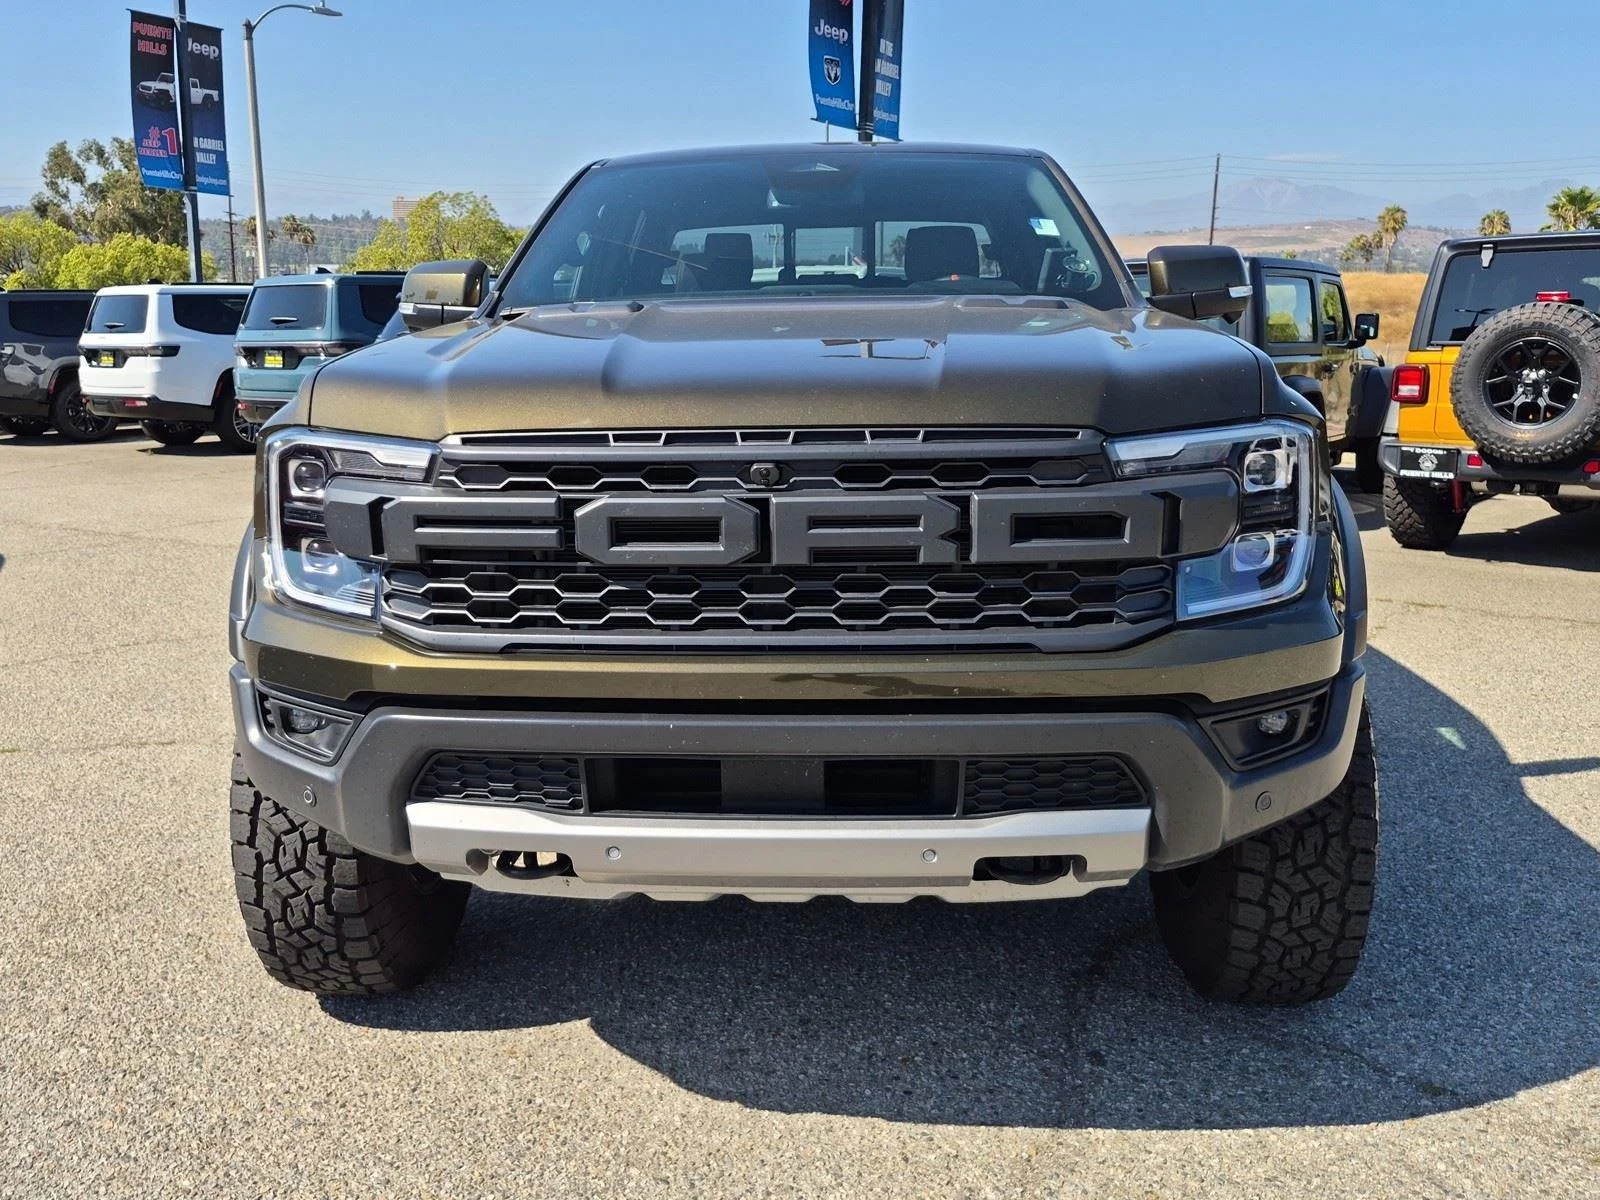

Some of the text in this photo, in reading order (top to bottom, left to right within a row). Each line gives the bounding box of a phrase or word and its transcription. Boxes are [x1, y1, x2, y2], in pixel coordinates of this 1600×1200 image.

[132, 21, 173, 40] PUENTE
[814, 18, 849, 45] Jeep
[137, 39, 167, 56] HILLS
[187, 37, 220, 60] Jeep
[199, 137, 225, 152] GABRIEL
[196, 151, 217, 165] VALLEY
[381, 491, 1166, 566] FORD
